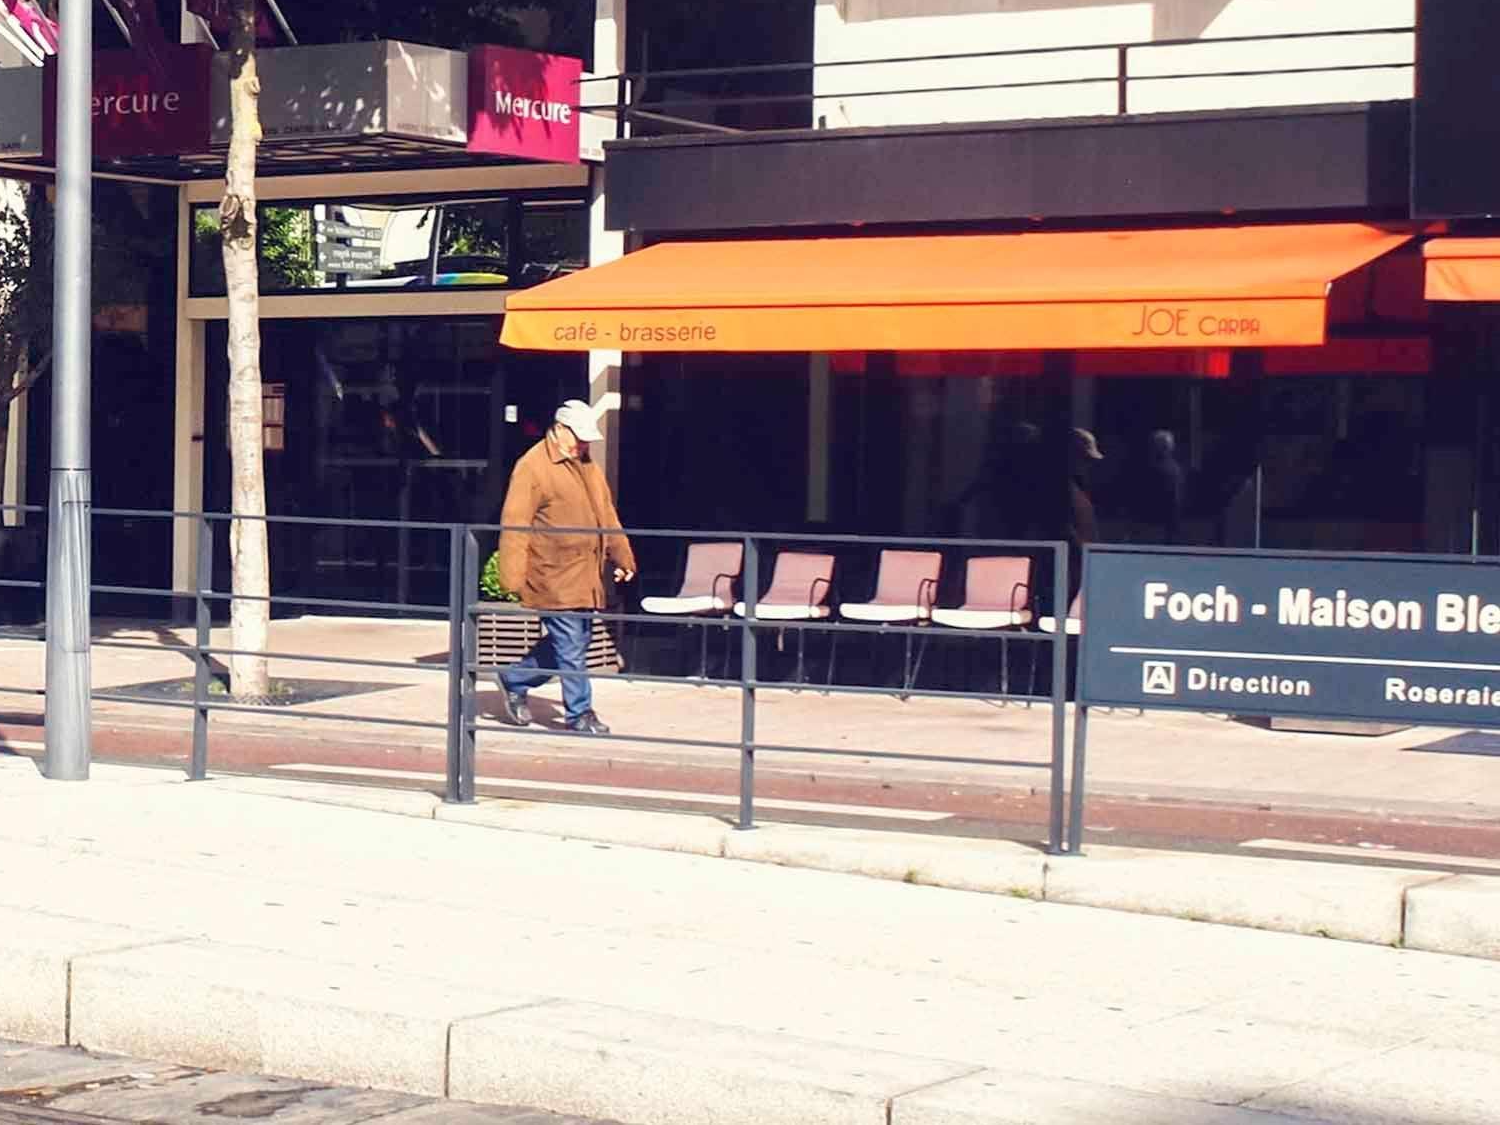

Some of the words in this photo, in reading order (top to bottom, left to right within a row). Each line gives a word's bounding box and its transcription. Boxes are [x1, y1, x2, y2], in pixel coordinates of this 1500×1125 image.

[91, 91, 180, 116] ercure
[495, 90, 572, 124] Mercure
[554, 322, 597, 341] café
[619, 321, 716, 342] brasserie
[1131, 305, 1189, 336] JOE
[1143, 582, 1240, 623] Foch
[1278, 587, 1423, 631] Maison
[1187, 668, 1312, 696] Direction
